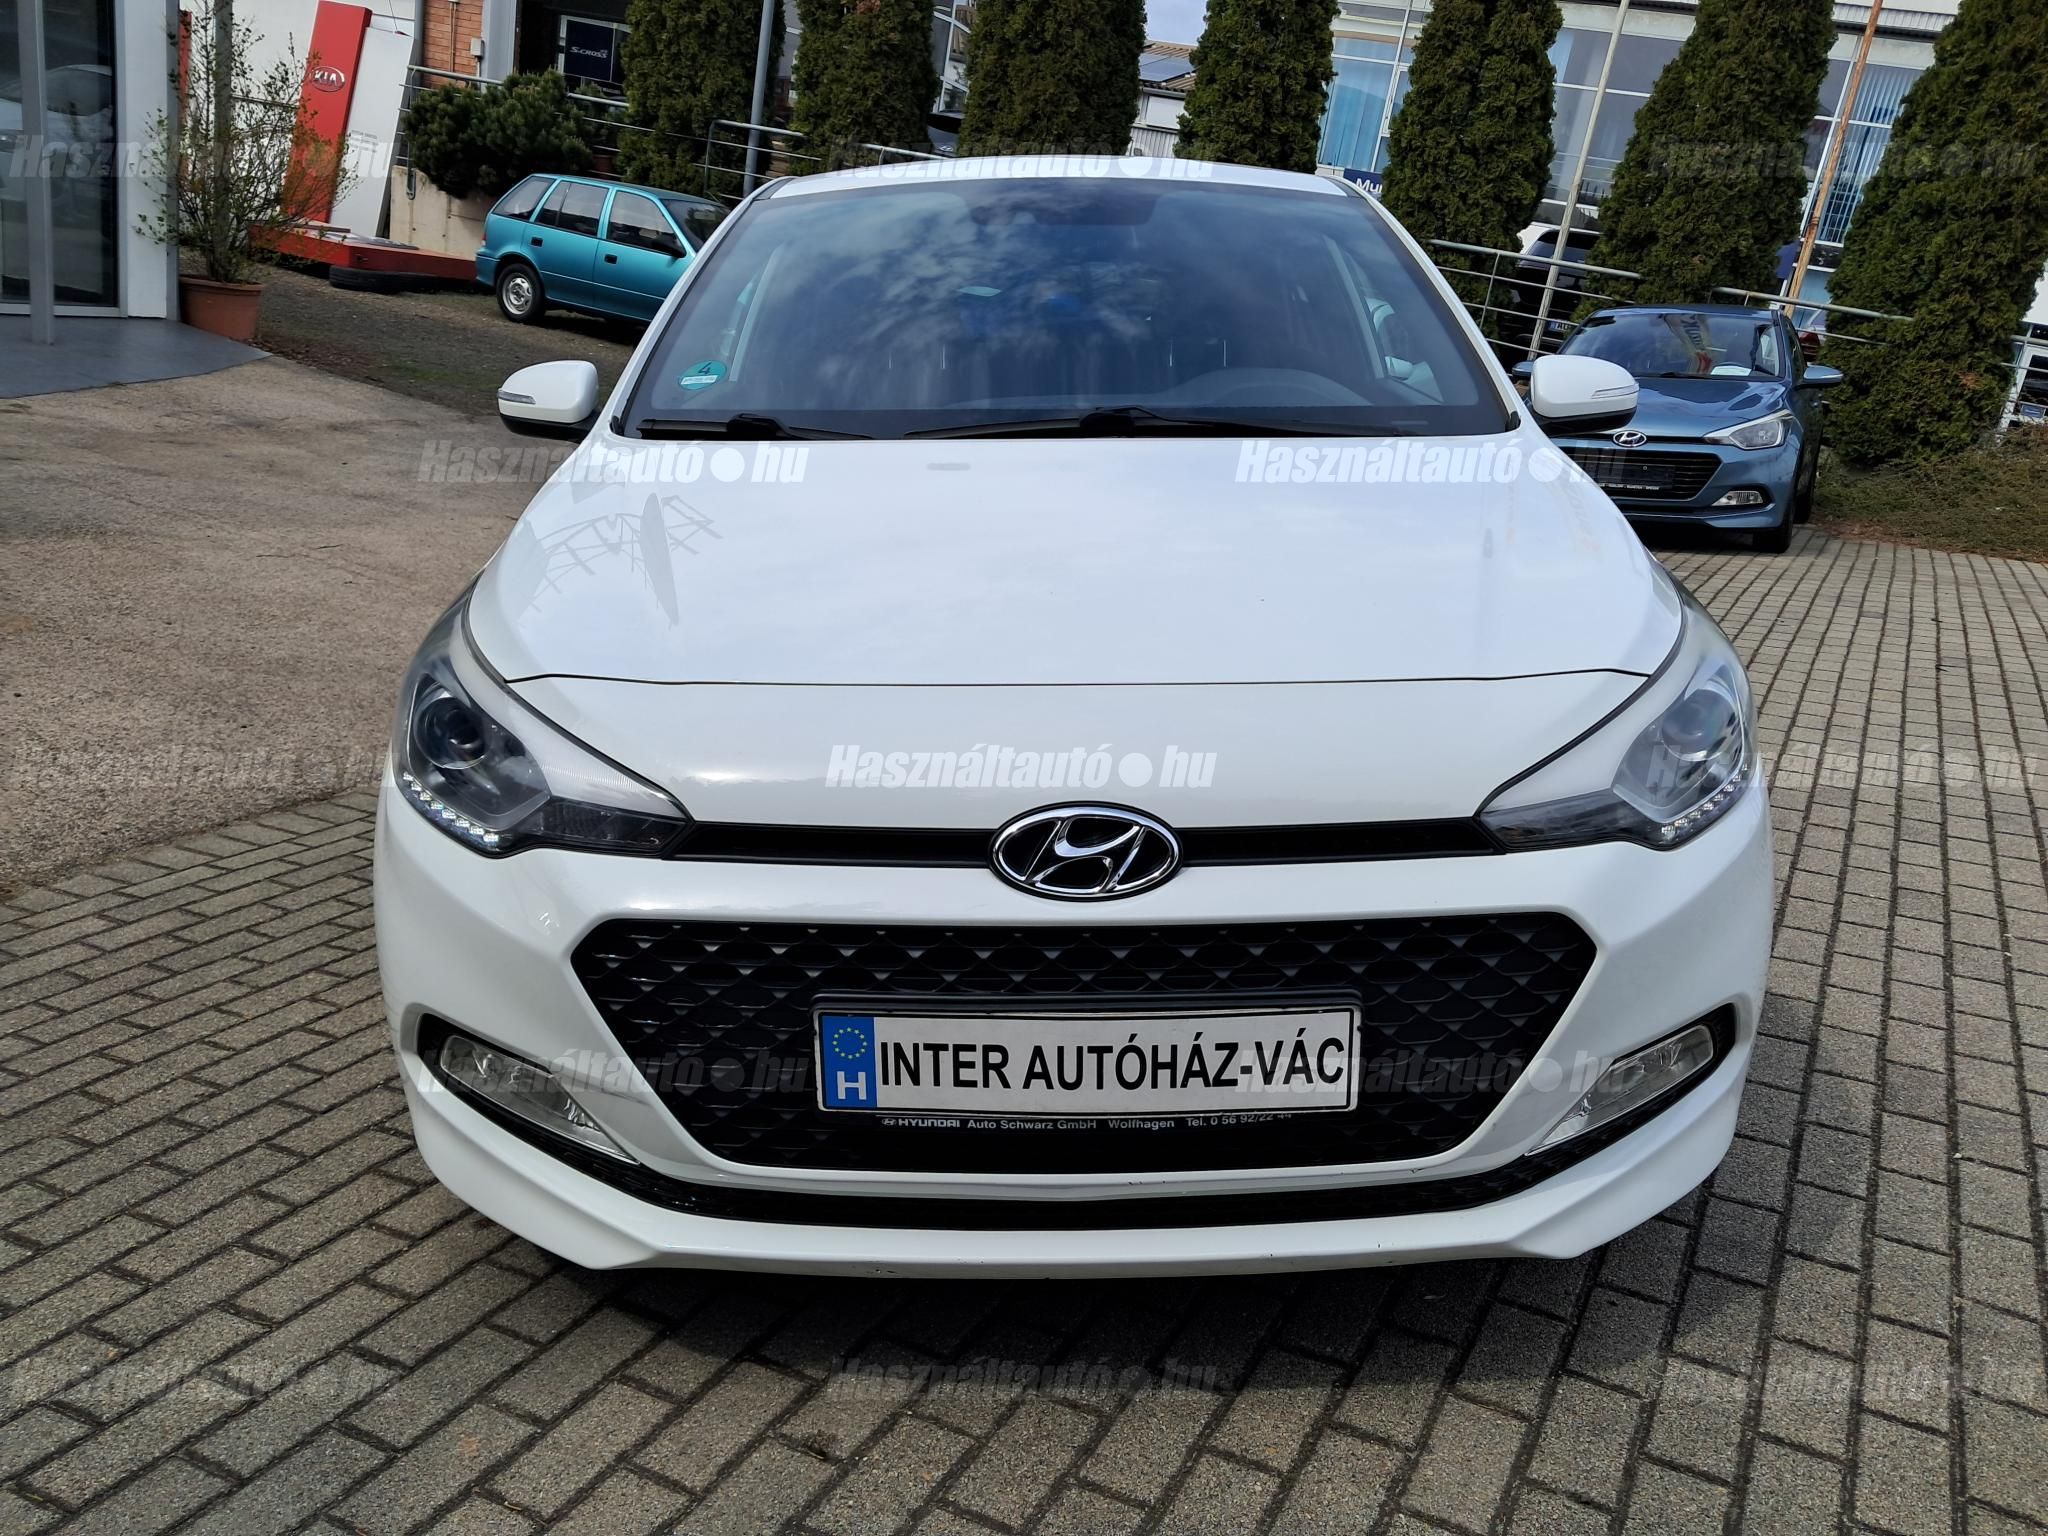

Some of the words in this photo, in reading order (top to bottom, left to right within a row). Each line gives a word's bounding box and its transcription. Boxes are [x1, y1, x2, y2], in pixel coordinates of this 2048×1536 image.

[314, 69, 338, 85] KIA
[698, 361, 713, 375] 4
[880, 1041, 1012, 1089] INTER
[1022, 1027, 1345, 1091] AUTÓHÁZ-VÁC
[836, 1070, 867, 1100] H
[898, 1118, 960, 1128] HYUNDAI
[967, 1119, 997, 1129] Auto
[1000, 1119, 1054, 1130] Schwarz
[1057, 1119, 1097, 1130] GmbH
[1108, 1118, 1175, 1131] Wolfhagen
[1186, 1117, 1207, 1127] Tel.
